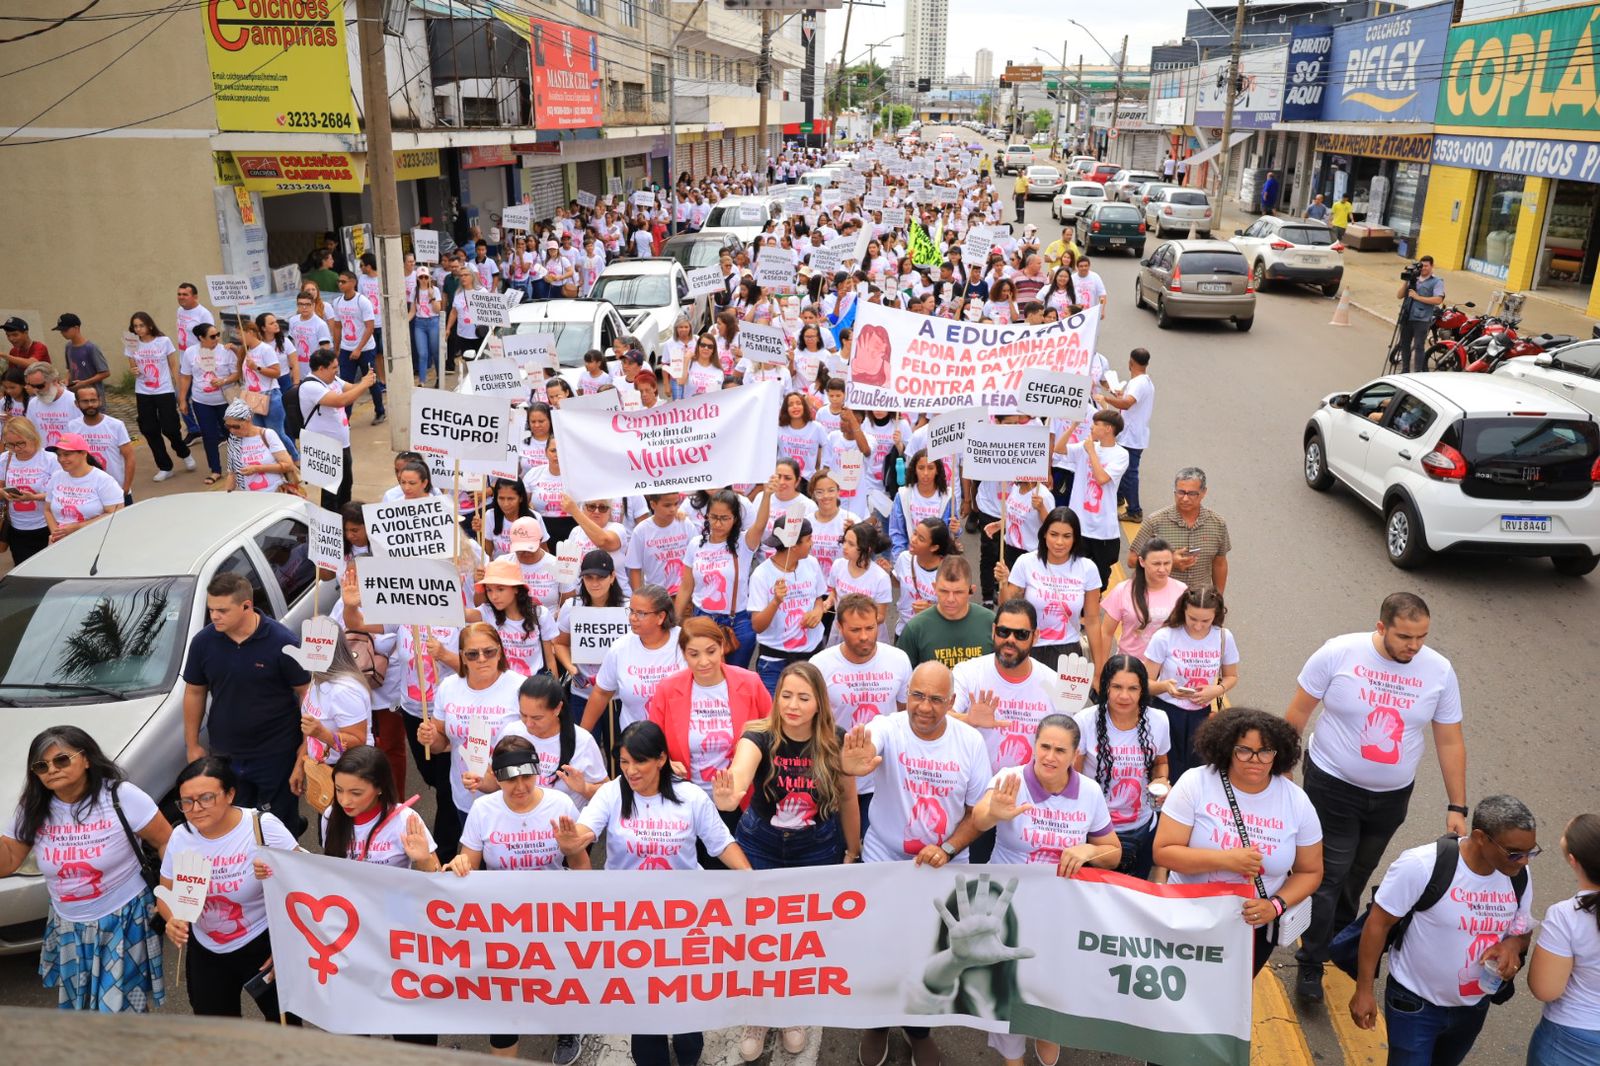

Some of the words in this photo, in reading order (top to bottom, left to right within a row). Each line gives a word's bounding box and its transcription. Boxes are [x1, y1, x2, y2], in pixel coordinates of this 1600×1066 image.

[1366, 17, 1412, 42] COLCHÕES
[1291, 37, 1331, 54] BARATO
[1292, 56, 1323, 83] SÓ
[1342, 39, 1425, 95] BIFLEX
[1447, 8, 1600, 117] COPLÁ
[547, 69, 574, 88] MASTER
[1285, 86, 1322, 105] AQUI
[287, 112, 351, 129] 3233-2684
[1381, 136, 1431, 160] ATACADO
[1499, 140, 1577, 177] ARTIGOS
[692, 275, 711, 283] CHEGA
[471, 293, 501, 302] COMBATE
[476, 308, 502, 317] CONTRA
[476, 315, 503, 324] MULHER
[919, 319, 935, 339] A
[742, 331, 783, 347] #RESPEITA
[907, 338, 955, 361] APOIA
[960, 347, 972, 363] A
[977, 332, 1081, 363] CAMINHADA
[745, 342, 755, 350] AS
[755, 344, 782, 355] MINAS
[902, 356, 941, 377] PELO
[946, 364, 976, 377] FIM
[981, 363, 1002, 375] DA
[481, 382, 507, 391] COLHER
[895, 375, 975, 396] CONTRA
[983, 378, 997, 391] A
[1027, 381, 1066, 397] CHEGA
[1068, 387, 1084, 398] DE
[903, 394, 974, 408] VEREADORA
[981, 390, 1018, 407] LÉIA
[1025, 393, 1083, 409] ESTUPRO!
[421, 407, 474, 427] CHEGA
[478, 415, 499, 429] DE
[611, 403, 720, 438] Caminhada
[420, 423, 499, 444] ESTUPRO!
[640, 429, 662, 441] pelo
[663, 427, 680, 437] fim
[680, 425, 693, 436] da
[684, 433, 709, 444] contra
[710, 432, 717, 440] a
[930, 423, 956, 438] LIGUE
[931, 434, 965, 449] DENUN
[967, 438, 989, 448] TODA
[989, 441, 1026, 449] MULHER
[1027, 441, 1046, 449] TEM
[303, 445, 332, 466] #CHEGA
[331, 454, 342, 467] DE
[626, 443, 713, 478] Mulher
[966, 446, 973, 454] O
[973, 447, 1006, 457] DIREITO
[1007, 449, 1019, 457] DE
[1020, 449, 1046, 457] VIVER
[973, 456, 992, 465] SEM
[307, 458, 337, 478] ASSÉDIO
[1522, 467, 1541, 481] FIAT
[634, 480, 647, 490] AD
[654, 474, 713, 488] BARRAVENTO
[376, 501, 443, 520] COMBATE
[371, 523, 381, 535] A
[382, 514, 455, 533] VIOLÊNCIA
[386, 529, 443, 546] CONTRA
[388, 542, 446, 558] MULHER
[364, 577, 414, 590] #NEM
[418, 578, 457, 593] UMA
[376, 592, 387, 605] A
[391, 593, 449, 607] MENOS
[305, 636, 334, 646] BASTA!
[579, 636, 595, 648] AS
[934, 646, 964, 659] VERÁS
[965, 646, 982, 658] QUE
[832, 670, 894, 686] Caminhada
[1060, 674, 1090, 685] BASTA!
[1354, 664, 1423, 688] Caminhada
[841, 691, 890, 707] Mulher
[1358, 687, 1415, 710] Mulher
[903, 778, 954, 799] Mulher
[1020, 827, 1082, 848] Mulher
[42, 844, 107, 867] Mulher
[626, 839, 682, 859] Mulher
[176, 873, 207, 886] BASTA!
[426, 898, 733, 933] CAMINHADA
[745, 890, 867, 927] PELO
[389, 929, 471, 969] FIM
[485, 941, 556, 970] DA
[564, 928, 826, 970] VIOLÊNCIA
[1077, 930, 1225, 964] DENUNCIE
[391, 968, 591, 1006] CONTRA
[600, 977, 636, 1005] A
[648, 966, 851, 1005] MULHER
[1108, 963, 1187, 1002] 180
